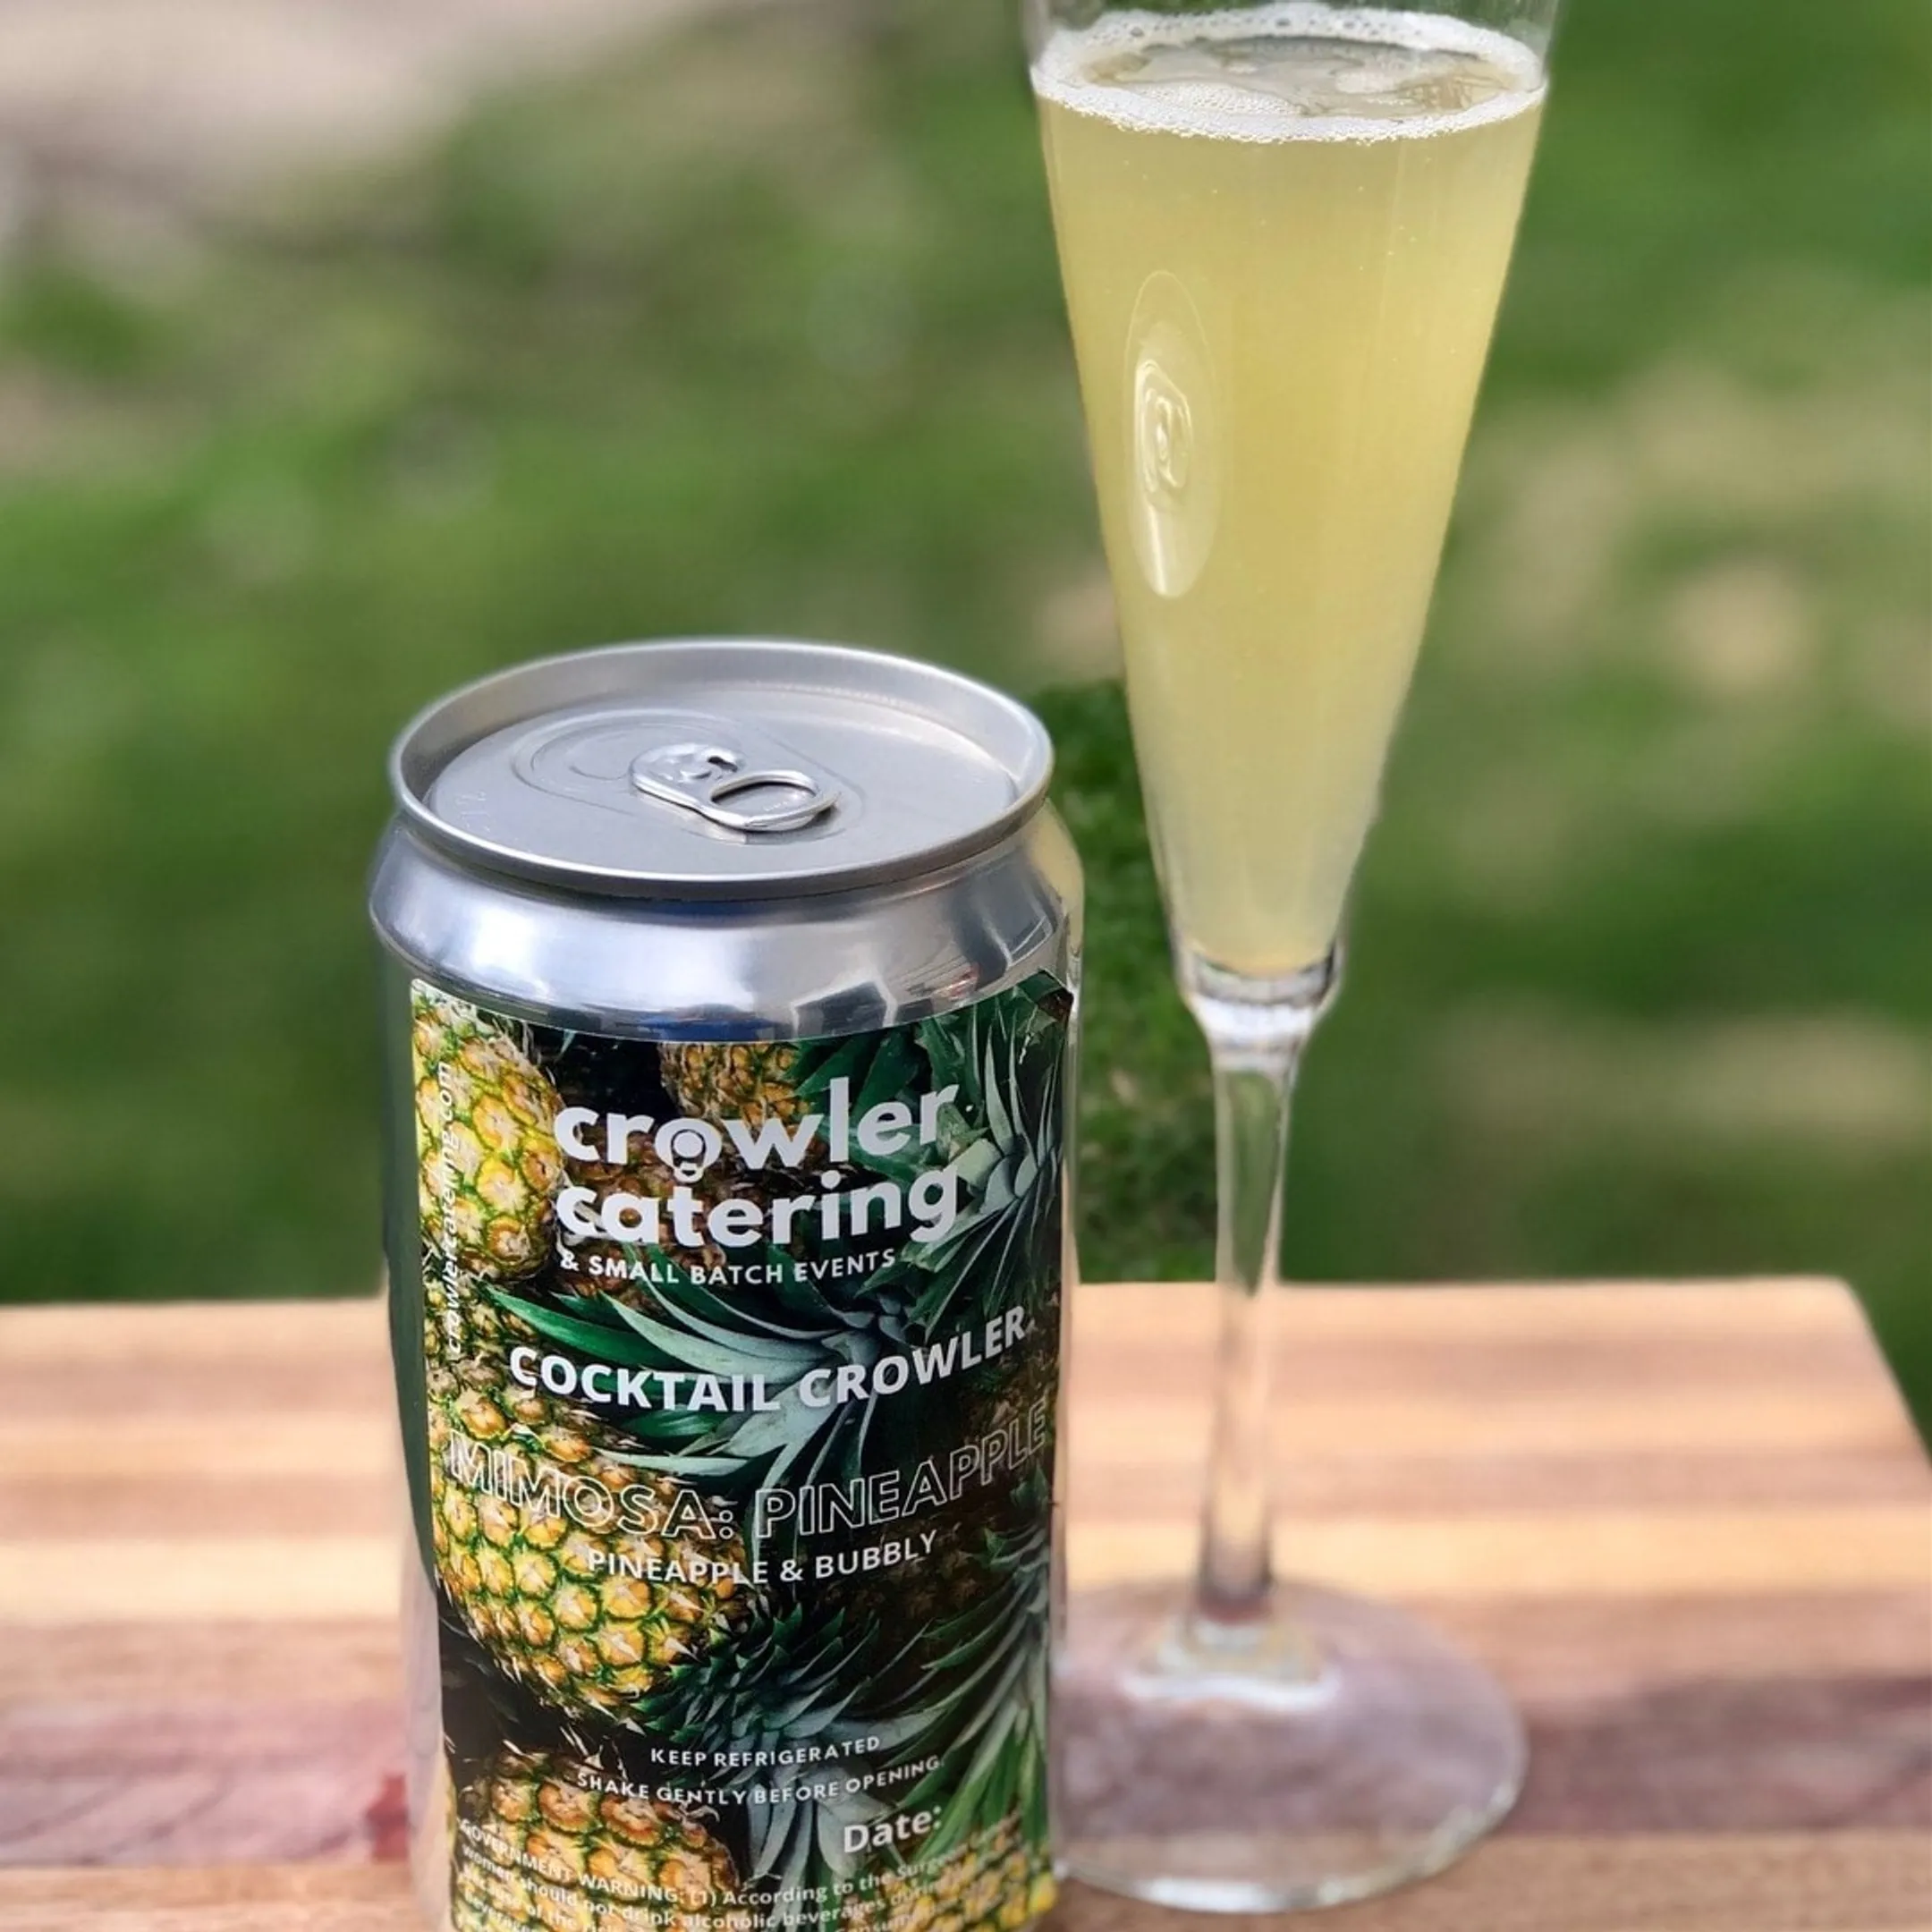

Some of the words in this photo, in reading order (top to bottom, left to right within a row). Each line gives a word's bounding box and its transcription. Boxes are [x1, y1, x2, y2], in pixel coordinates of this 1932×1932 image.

[554, 1076, 960, 1182] crowler
[437, 1062, 462, 1355] crowlercatering.com
[556, 1164, 958, 1248] catering
[560, 1249, 580, 1272] &
[589, 1255, 679, 1284] SMALL
[691, 1263, 784, 1286] BATCH
[795, 1248, 895, 1283] EVENTS
[509, 1346, 780, 1413] COCKTAIL
[799, 1305, 1026, 1408] CROWLER
[450, 1430, 734, 1540] MIMOSA:
[755, 1395, 1047, 1540] PINEAPPLE
[588, 1548, 768, 1585] PINEAPPLE
[780, 1559, 804, 1583] &
[815, 1530, 938, 1580] BUBBLY
[577, 1772, 649, 1800] SHAKE
[657, 1787, 747, 1805] GENTLY
[755, 1784, 839, 1805] BEFORE
[846, 1754, 941, 1794] OPENING
[651, 1748, 707, 1767] KEEP
[715, 1735, 880, 1767] REFRIGERATED
[459, 1818, 573, 1881] GOVERNMENT
[580, 1874, 683, 1902] WARNING:
[722, 1885, 828, 1905] According
[834, 1880, 853, 1895] to
[843, 1805, 942, 1853] Date:
[682, 1911, 776, 1931] alcoholic
